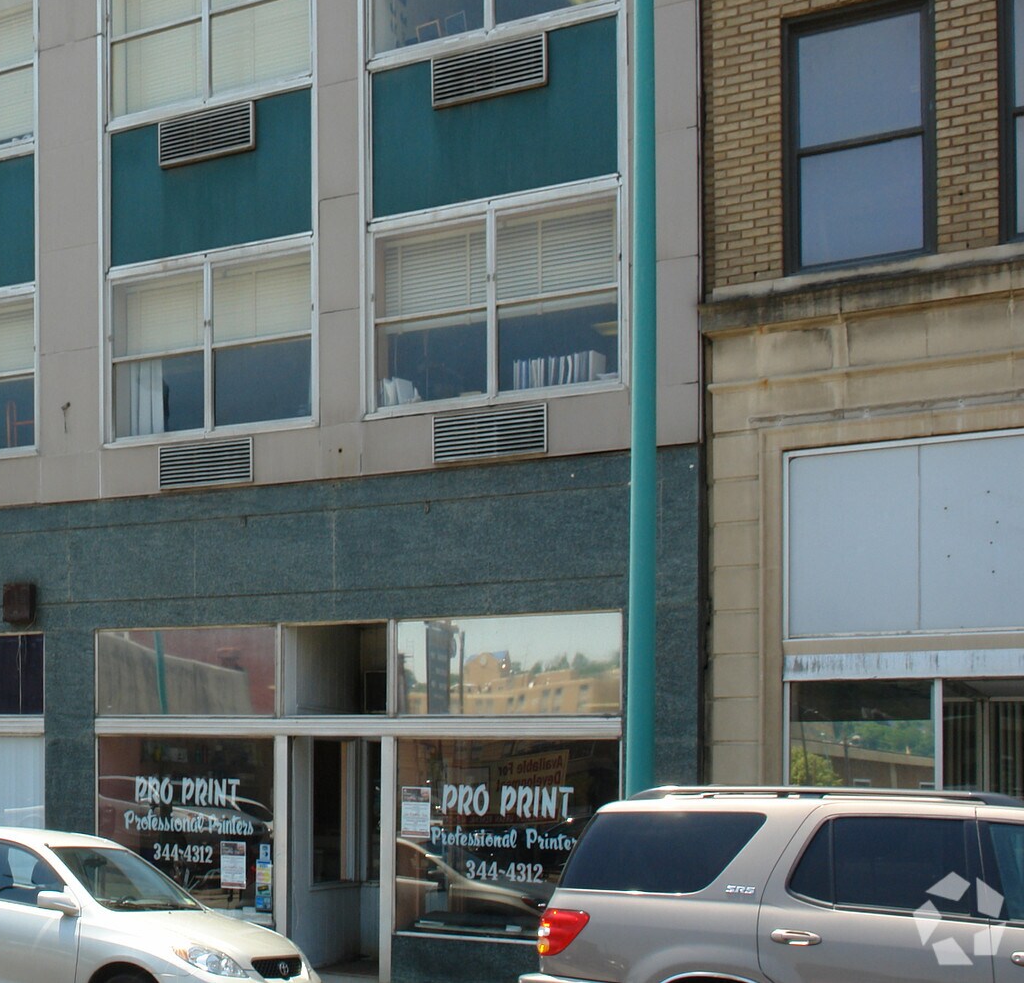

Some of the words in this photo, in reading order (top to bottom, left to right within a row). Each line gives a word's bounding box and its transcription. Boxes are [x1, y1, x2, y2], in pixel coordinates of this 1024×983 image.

[134, 775, 173, 805] PRO
[181, 777, 240, 807] PRINT
[441, 783, 490, 817] PRO
[499, 785, 574, 819] PRINT
[124, 810, 204, 834] Professional
[208, 817, 254, 835] Printers
[431, 825, 518, 849] Professional
[525, 827, 577, 851] Printer
[153, 842, 214, 864] 344-4312
[465, 860, 544, 884] 344-4312
